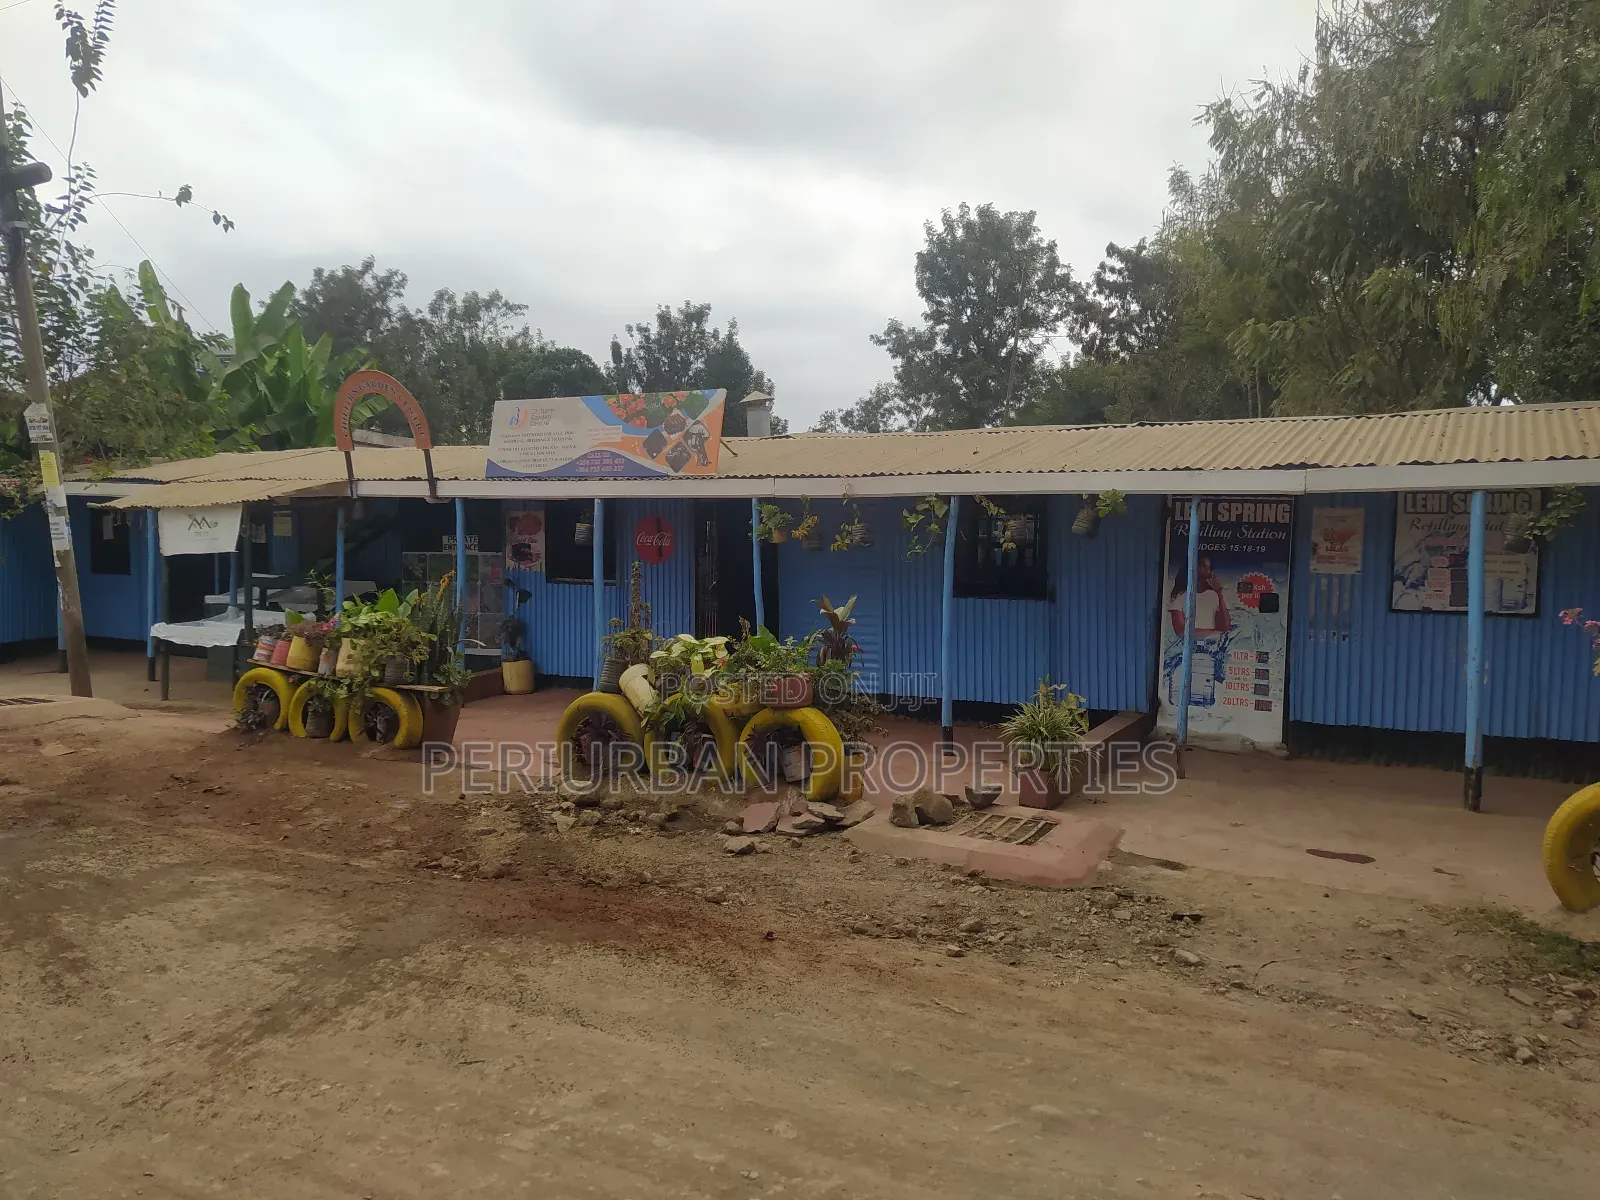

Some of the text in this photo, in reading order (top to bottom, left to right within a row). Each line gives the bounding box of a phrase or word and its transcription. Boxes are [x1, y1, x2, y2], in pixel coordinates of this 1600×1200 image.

[358, 380, 397, 396] GARDEN
[1405, 491, 1449, 514] LEHI
[1217, 502, 1290, 524] SPRING
[636, 531, 672, 547] Coca-Cola
[1237, 524, 1287, 540] Station
[1229, 544, 1266, 553] 15:18-19
[1241, 592, 1253, 601] per
